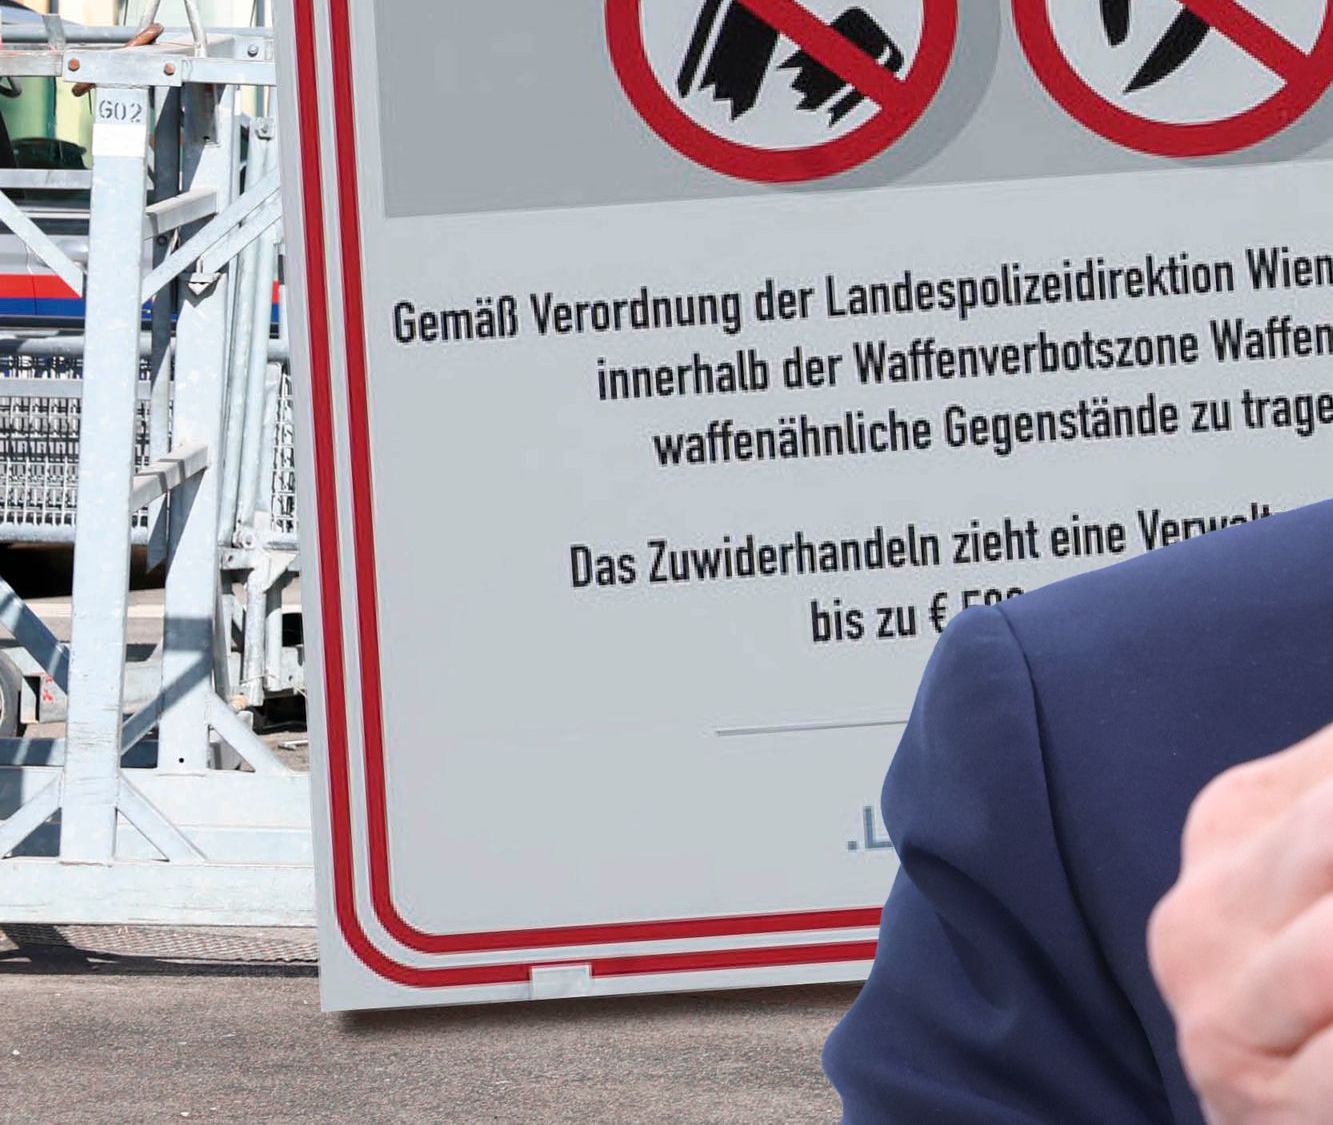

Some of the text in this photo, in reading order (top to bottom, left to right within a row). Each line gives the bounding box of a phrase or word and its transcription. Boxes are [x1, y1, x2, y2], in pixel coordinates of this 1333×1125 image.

[392, 293, 519, 345] Gemäß
[529, 286, 742, 336] Verordnung
[754, 278, 814, 322] der
[825, 252, 1235, 320] Landespolizeidirektion
[597, 348, 769, 402] innerhalb
[782, 345, 843, 389] der
[853, 329, 1200, 386] Waffenverbotszone
[653, 408, 932, 468] waffenähnliche
[944, 392, 1179, 457] Gegenstände
[1190, 399, 1231, 434] zu
[569, 542, 637, 588] Das
[647, 523, 941, 584] Zuwiderhandeln
[952, 515, 1040, 565] zieht
[1051, 514, 1126, 559] eine
[810, 597, 864, 643] bis
[876, 605, 917, 640] zu
